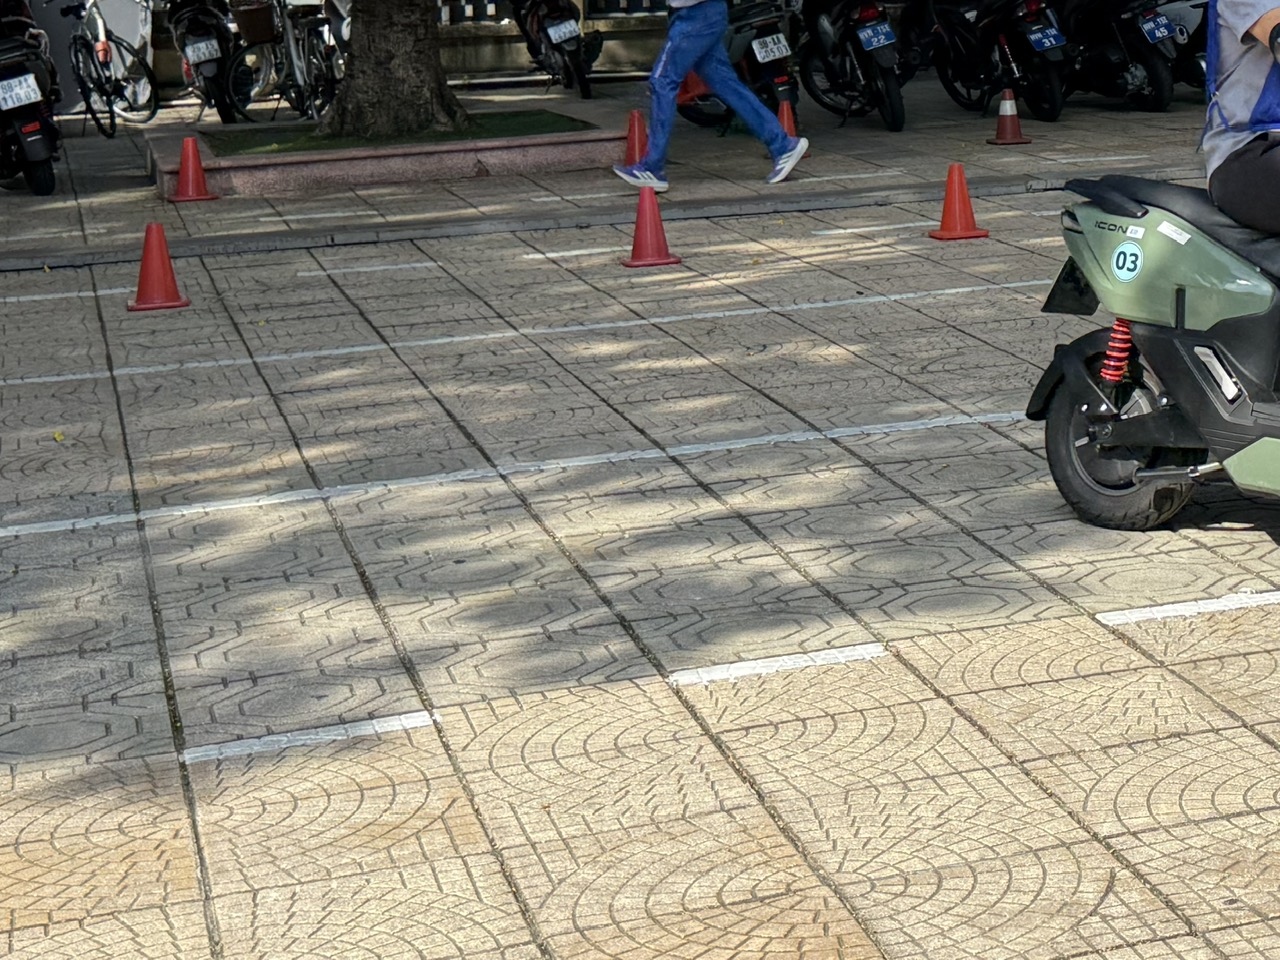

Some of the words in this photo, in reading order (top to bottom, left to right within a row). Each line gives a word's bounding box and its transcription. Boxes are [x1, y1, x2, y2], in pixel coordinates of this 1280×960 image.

[1155, 27, 1168, 37] 45
[871, 35, 887, 46] 22
[1042, 37, 1056, 47] 31
[1095, 221, 1128, 233] ICON
[1115, 250, 1139, 272] 03
